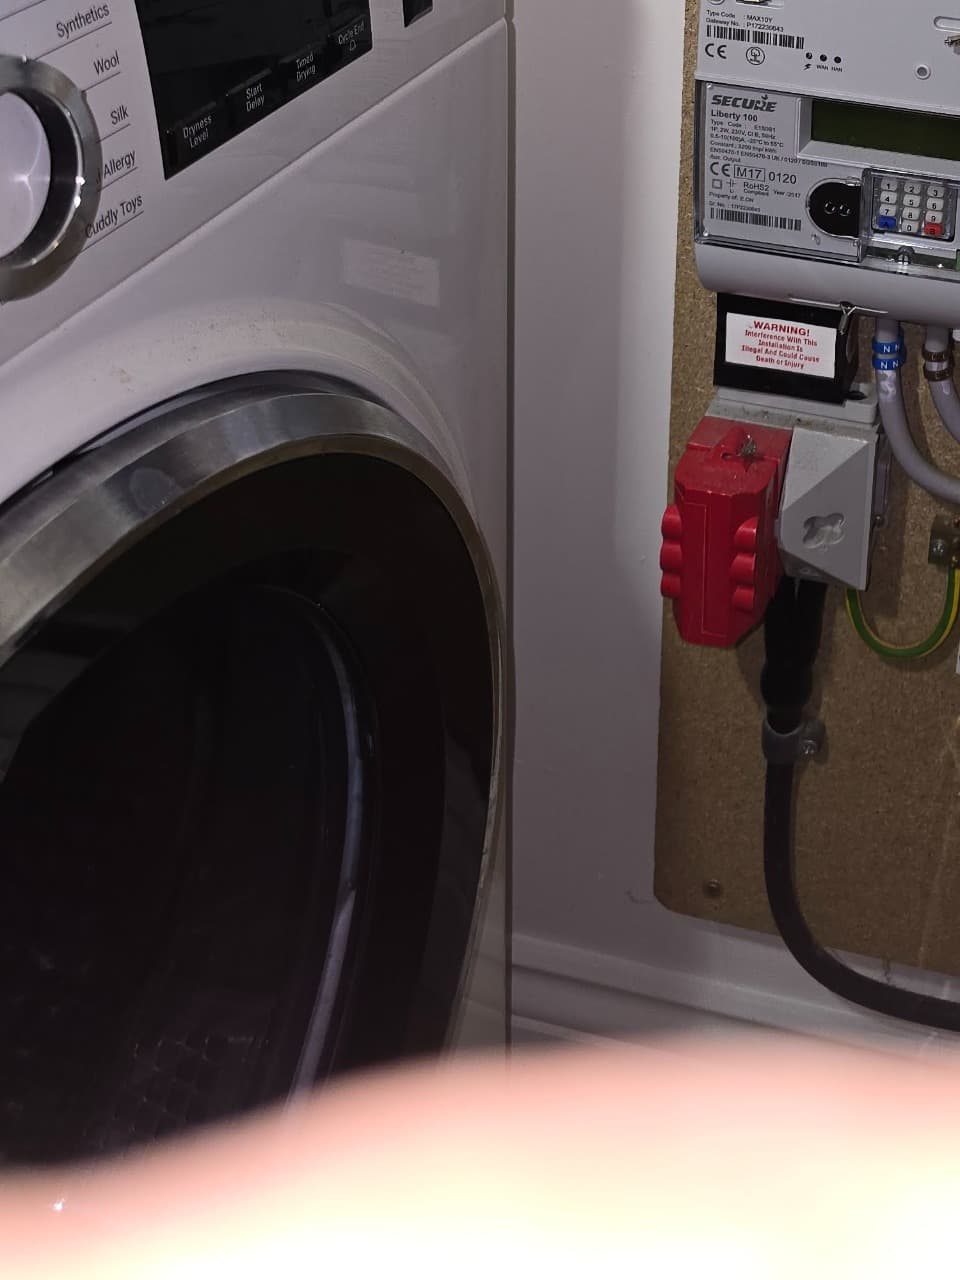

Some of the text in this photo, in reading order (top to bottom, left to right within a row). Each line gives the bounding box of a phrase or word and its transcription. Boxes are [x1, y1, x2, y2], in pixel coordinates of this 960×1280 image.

[56, 3, 110, 39] Synthetics
[338, 21, 365, 45] Cycle End
[93, 50, 120, 75] Wool
[246, 83, 262, 100] Start
[246, 94, 265, 112] Delay
[711, 94, 777, 113] SECURE
[110, 104, 129, 126] Silk
[711, 109, 758, 122] Liberty 100
[183, 115, 212, 139] Dryness
[189, 128, 209, 148] Level
[103, 150, 136, 179] Allergy
[736, 167, 797, 185] M17 0120
[743, 181, 770, 191] RoHS2
[85, 195, 143, 239] Cuddly Toys
[744, 329, 818, 347] Interference With This
[753, 320, 810, 337] WARNING!
[741, 344, 820, 363] Illegal And Could Cause
[758, 339, 795, 351] Installation
[756, 355, 804, 370] Death Injury
